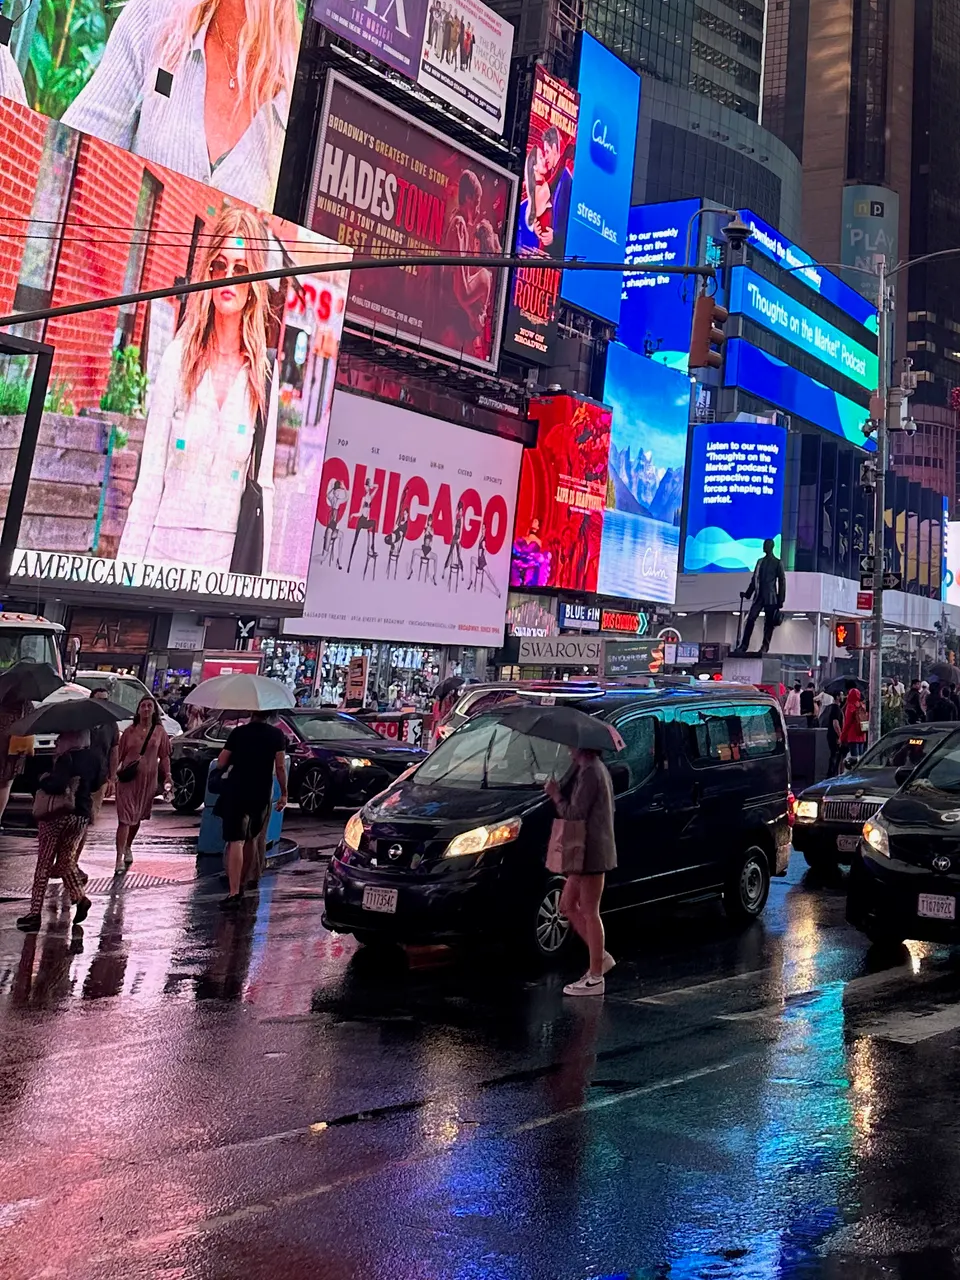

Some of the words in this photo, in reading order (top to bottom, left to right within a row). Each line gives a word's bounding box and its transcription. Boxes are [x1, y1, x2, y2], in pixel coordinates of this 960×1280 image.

[351, 7, 364, 25] THE
[489, 38, 507, 60] PLAY
[488, 52, 508, 77] GOES
[473, 56, 506, 93] WRONG
[592, 119, 618, 156] Calm
[328, 114, 375, 150] BROADWAY'S
[375, 140, 410, 167] GREATEST
[410, 158, 427, 177] LOVE
[428, 167, 450, 188] STORY
[317, 196, 349, 220] WINNER!
[356, 213, 376, 235] TONY
[576, 200, 602, 227] stress
[601, 219, 618, 244] less
[337, 222, 368, 251] BEST
[629, 232, 638, 242] to
[638, 231, 652, 241] our
[652, 228, 679, 239] weekly
[643, 242, 654, 252] on
[654, 240, 668, 250] the
[633, 252, 665, 266] podcast
[664, 251, 677, 261] for
[626, 276, 656, 288] shaping
[656, 275, 670, 285] the
[789, 314, 800, 336] on
[801, 318, 814, 343] the
[840, 344, 867, 377] Podcast
[337, 438, 349, 447] POP
[706, 441, 729, 451] Listen
[730, 441, 740, 451] to
[740, 442, 756, 451] our
[756, 443, 780, 455] weekly
[747, 453, 759, 461] on
[759, 453, 772, 463] the
[736, 463, 769, 473] podcast
[768, 464, 778, 474] for
[704, 473, 750, 484] perspective
[751, 475, 762, 483] on
[762, 475, 774, 484] the
[703, 484, 728, 493] forces
[729, 483, 761, 495] shaping
[762, 485, 774, 495] the
[315, 456, 509, 556] CHICAGO
[703, 494, 733, 504] market.
[641, 547, 669, 580] Calm
[17, 552, 138, 586] AMERICAN
[142, 565, 202, 592] EAGLE
[205, 571, 306, 603] OUTFITTERS
[565, 604, 585, 619] BLUE
[587, 606, 600, 621] FIN
